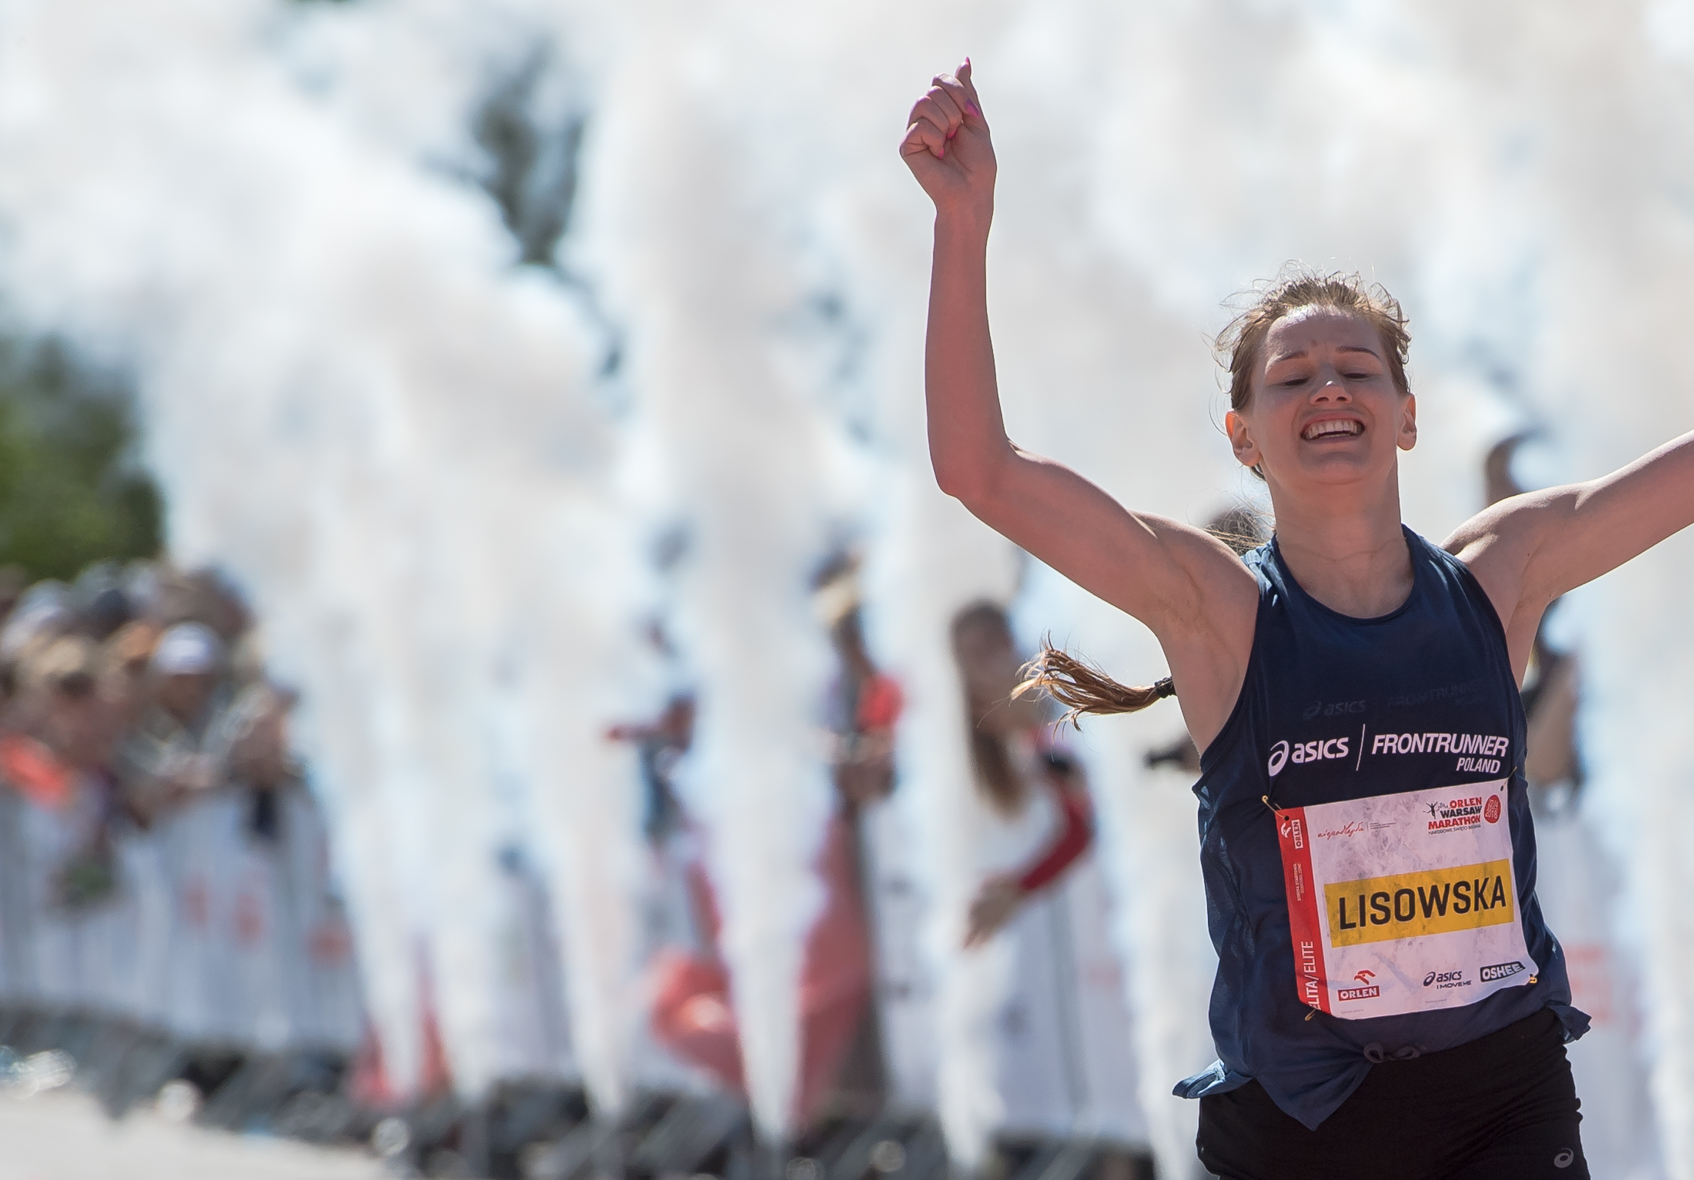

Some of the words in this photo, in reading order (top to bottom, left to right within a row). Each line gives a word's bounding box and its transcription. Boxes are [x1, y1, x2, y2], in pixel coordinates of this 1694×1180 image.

[1291, 737, 1349, 764] asics
[1371, 732, 1509, 758] FRONTRUNNER
[1456, 757, 1501, 774] POLAND
[1449, 797, 1482, 809] ORLEN
[1440, 806, 1482, 818] WARSAW
[1428, 815, 1481, 830] MARATHON
[1292, 821, 1302, 848] ORLEN
[1339, 875, 1507, 930] LISOWSKA
[1436, 971, 1462, 983] asics
[1481, 962, 1523, 981] OSHEE
[1340, 987, 1378, 999] ORLEN
